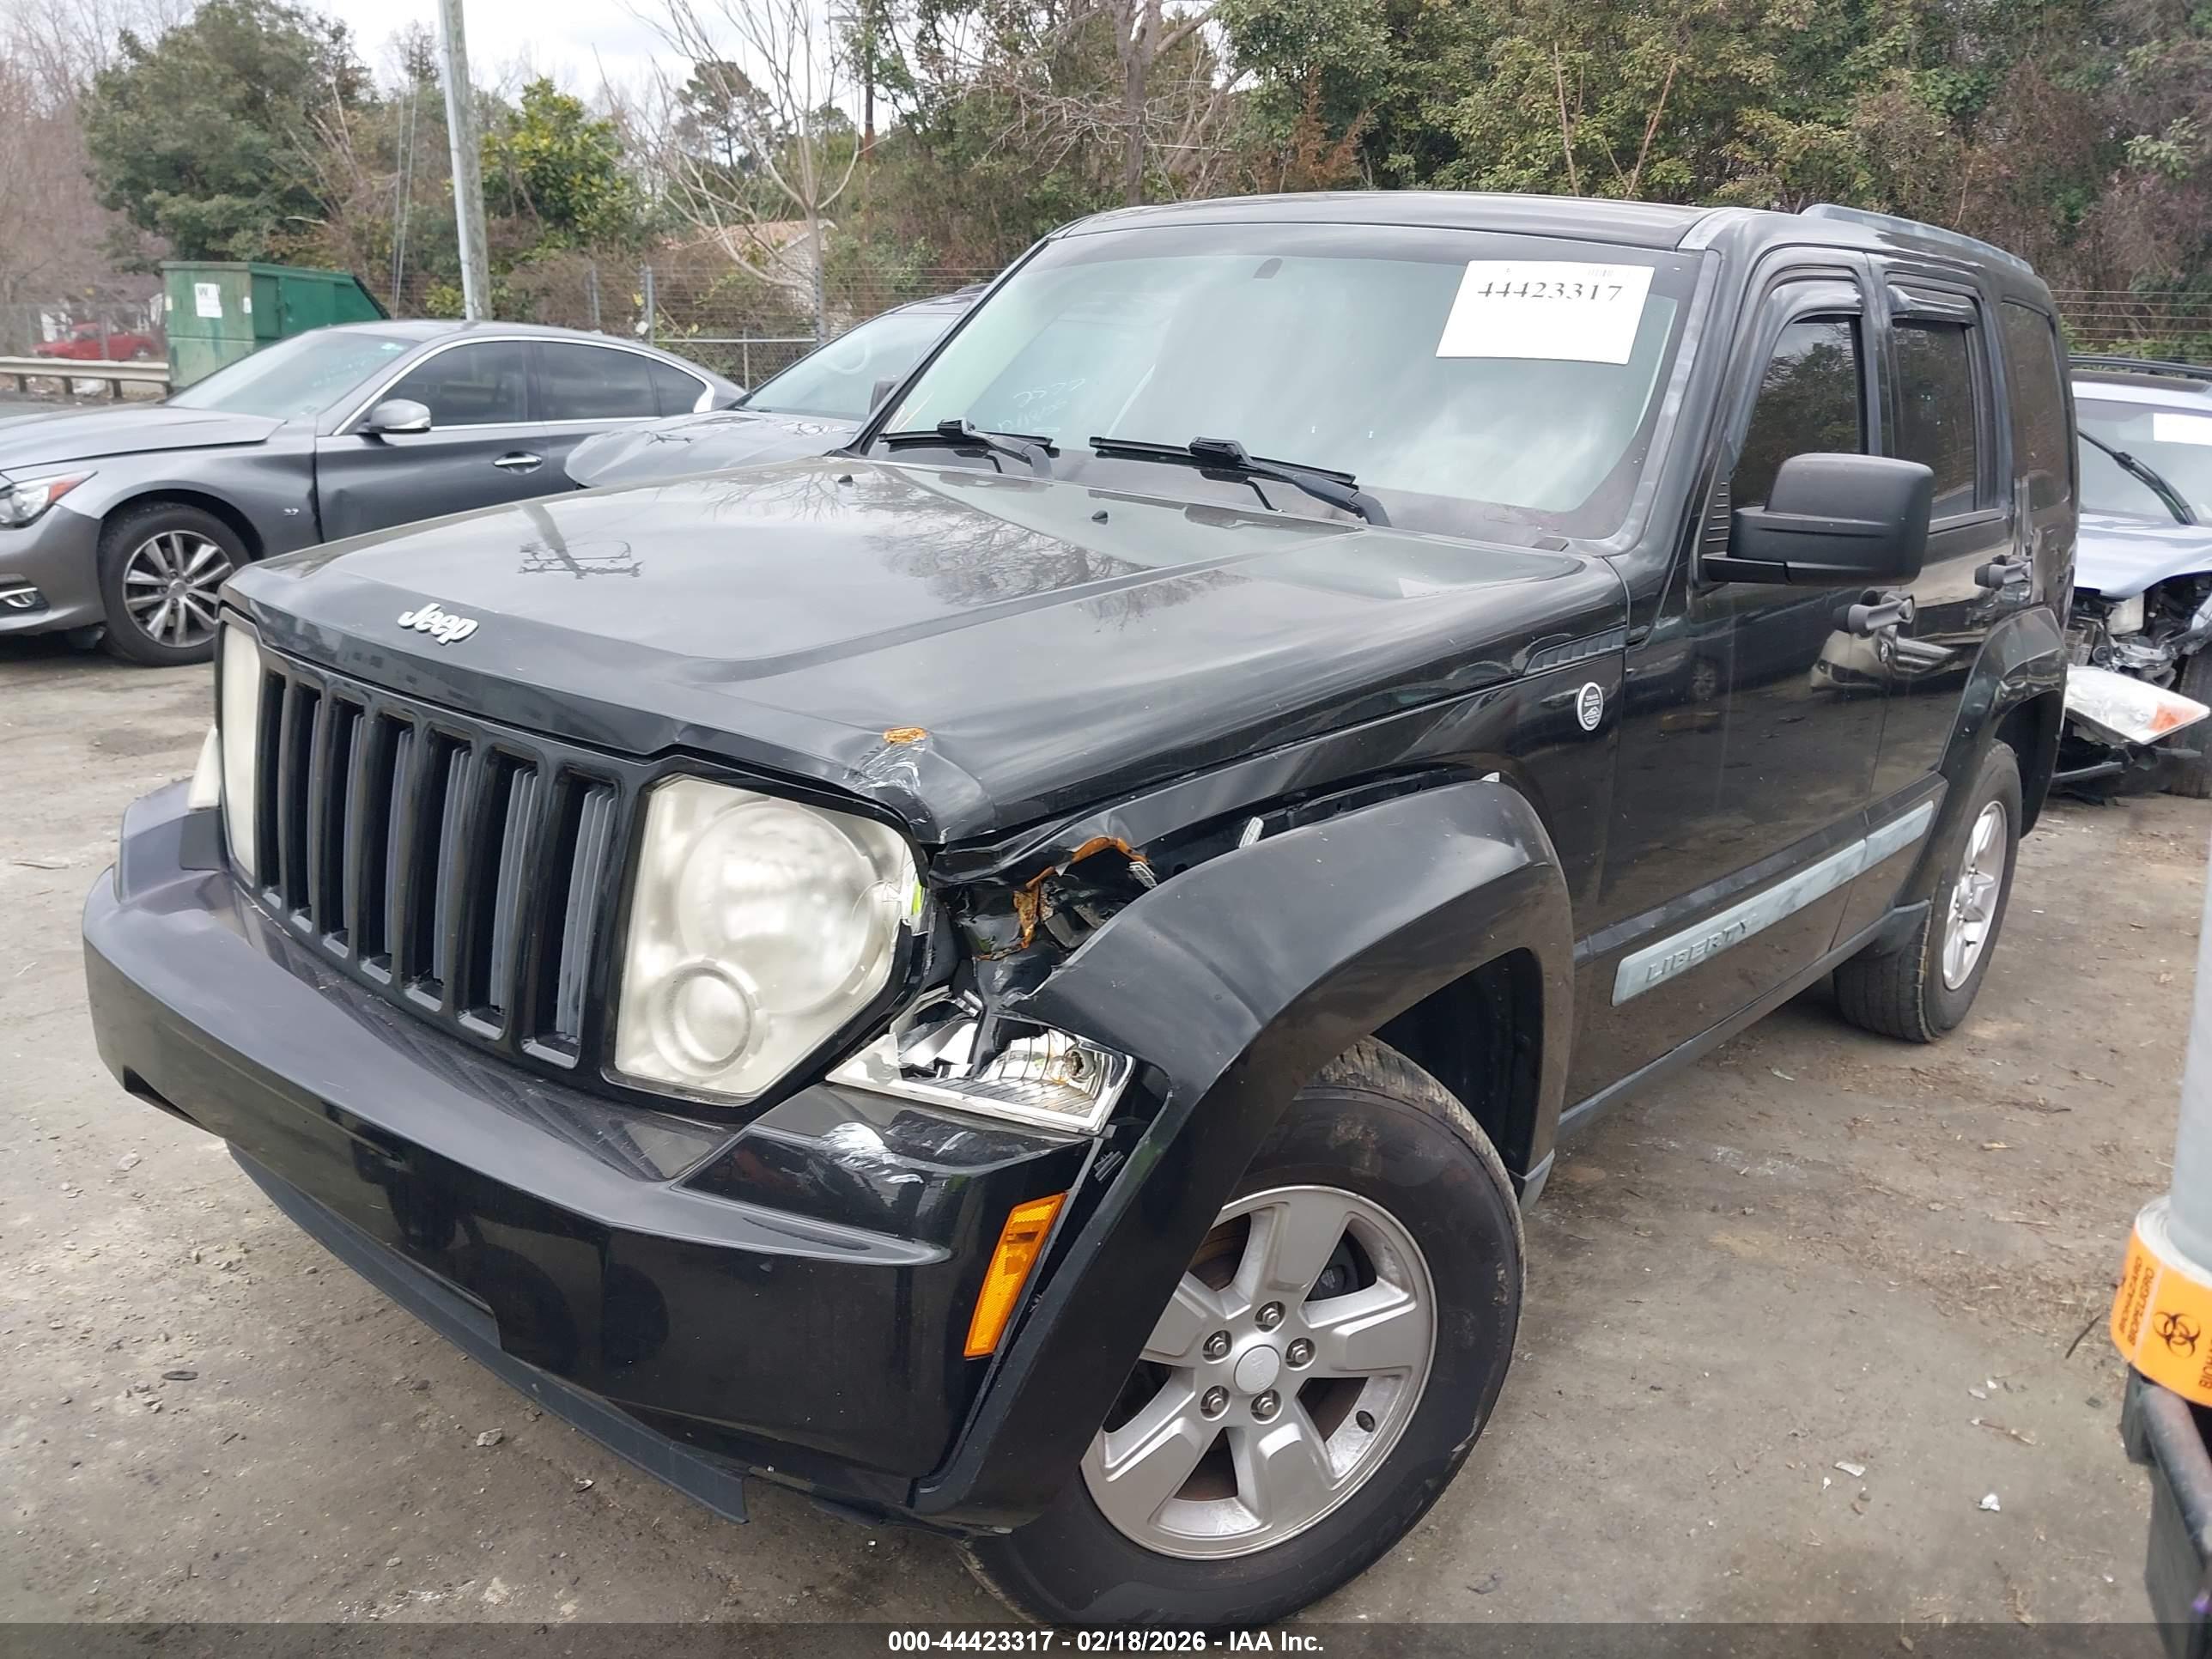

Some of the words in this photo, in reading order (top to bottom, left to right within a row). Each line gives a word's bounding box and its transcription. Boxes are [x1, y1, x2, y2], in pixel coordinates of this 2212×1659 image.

[1477, 281, 1624, 301] 44423317
[398, 603, 478, 646] Jeep
[1646, 918, 1748, 983] LIBERTY
[2127, 1267, 2155, 1346] BIOPELIGRO
